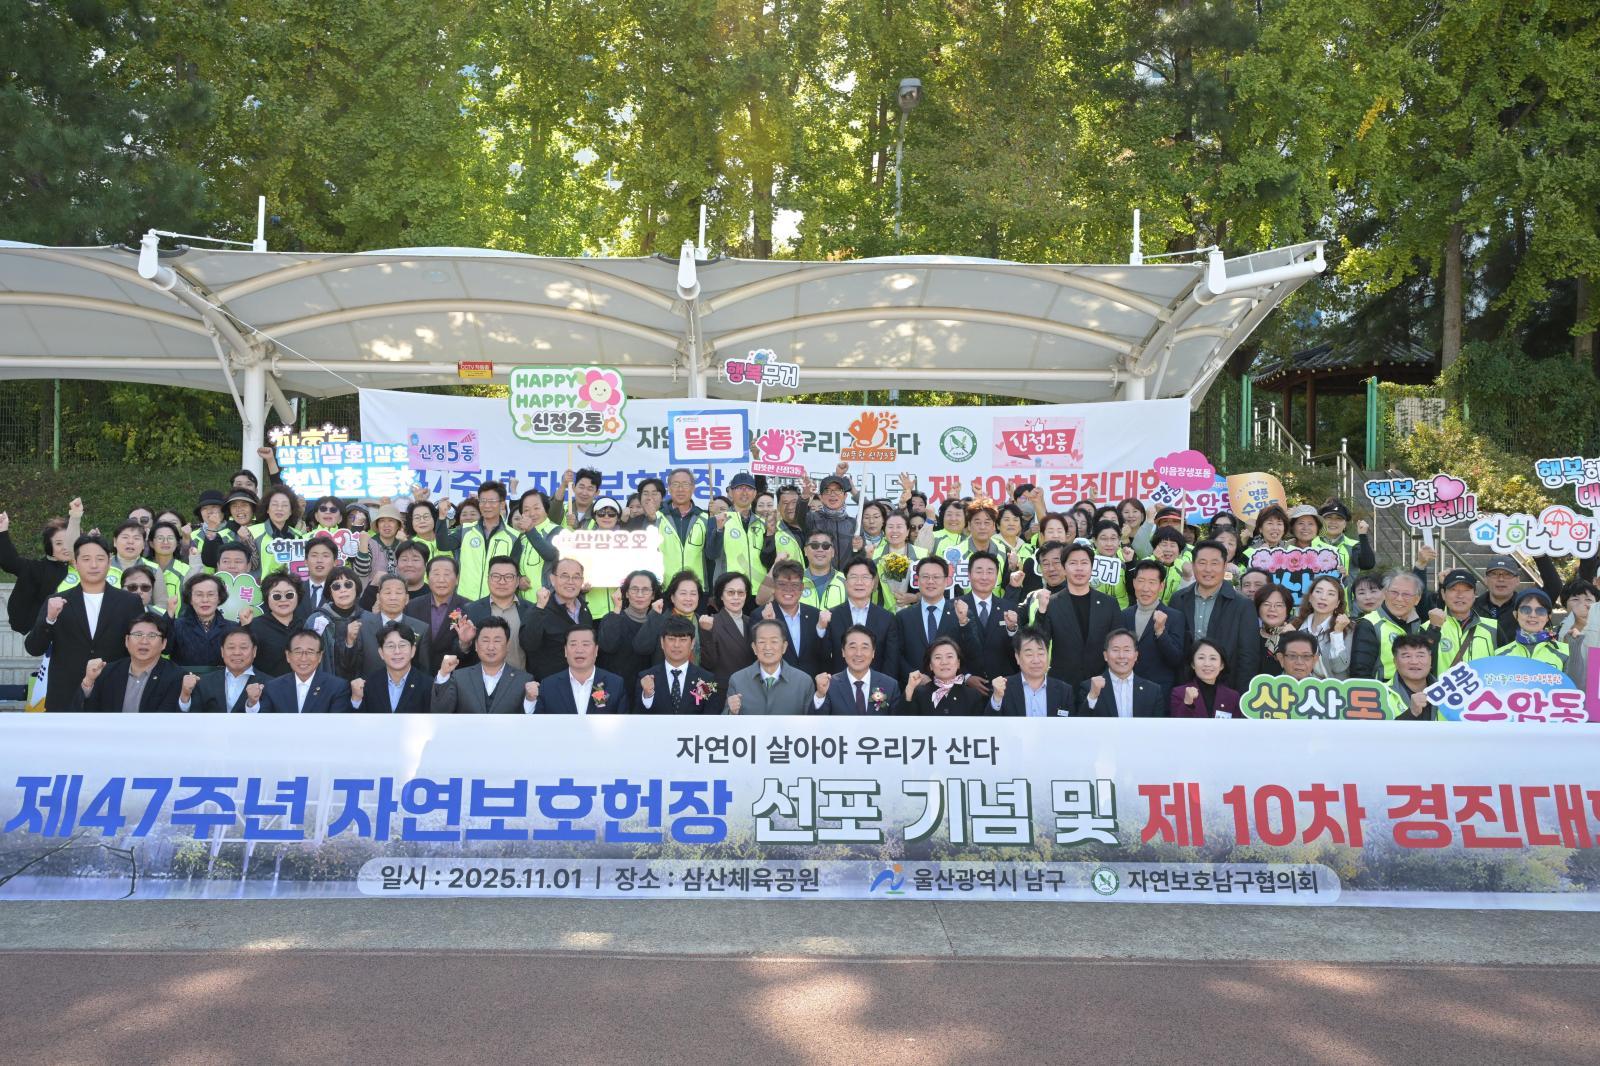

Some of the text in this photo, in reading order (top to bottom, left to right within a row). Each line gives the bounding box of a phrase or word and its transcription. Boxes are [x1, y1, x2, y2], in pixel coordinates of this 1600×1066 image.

[516, 373, 578, 388] HAPPY
[516, 394, 578, 408] HAPPY
[532, 411, 603, 434] 신정2동
[684, 426, 733, 451] 달동
[1009, 432, 1068, 453] 신정1동
[418, 441, 475, 463] 신정5동
[1407, 495, 1475, 527] 대현!!
[575, 533, 648, 550] 삼삼오오
[1427, 665, 1480, 706] 명품
[677, 735, 1000, 766] 자연이 살아야 우리가 산다
[3, 774, 309, 841] 제47주년
[327, 777, 733, 844] 자연보호헌장
[752, 777, 885, 846] 선포
[901, 778, 1034, 847] 기념
[1051, 778, 1121, 846] 및
[1138, 782, 1204, 847] 제
[1222, 783, 1367, 848] 10차
[381, 865, 427, 890] 일시
[448, 867, 582, 889] 2025.11.01
[614, 866, 661, 891] 장소
[681, 867, 820, 892] 삼산체육공원
[913, 868, 1017, 892] 울산광역시
[1025, 869, 1066, 892] 남구
[1127, 869, 1320, 894] 자연보호남구협의회
